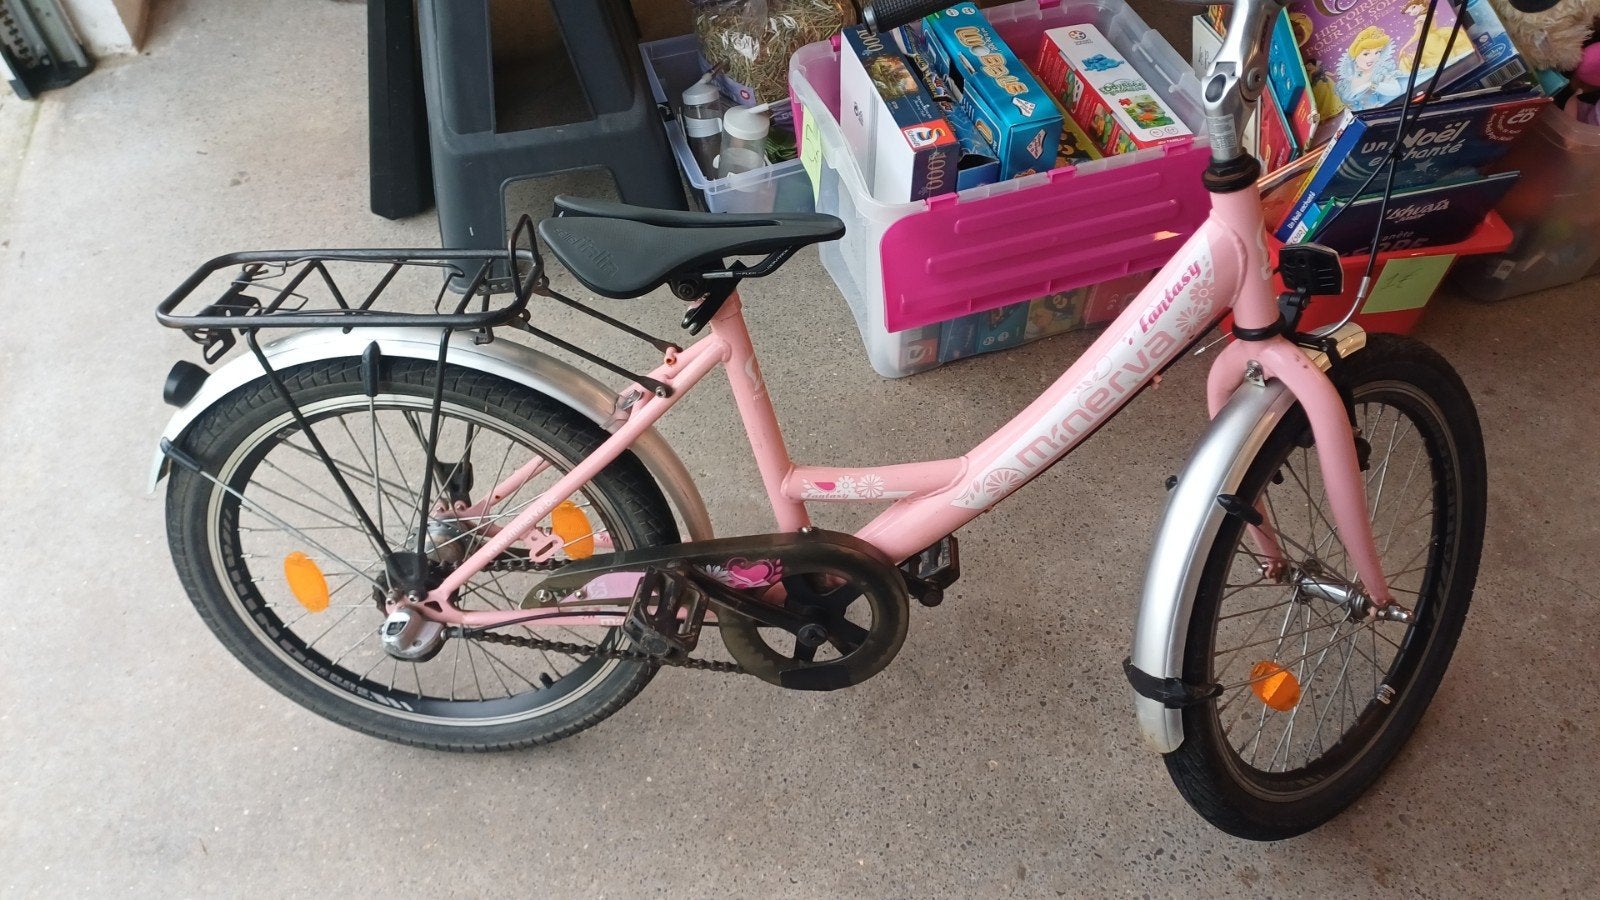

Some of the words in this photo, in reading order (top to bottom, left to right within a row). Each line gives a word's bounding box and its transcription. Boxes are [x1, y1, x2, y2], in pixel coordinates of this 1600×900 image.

[1306, 29, 1343, 56] POUR
[1346, 15, 1366, 31] LE
[1387, 120, 1471, 153] Noël
[1507, 111, 1536, 126] CD
[1368, 137, 1467, 167] ehanté
[925, 152, 947, 191] 1000
[1014, 329, 1177, 469] minerva
